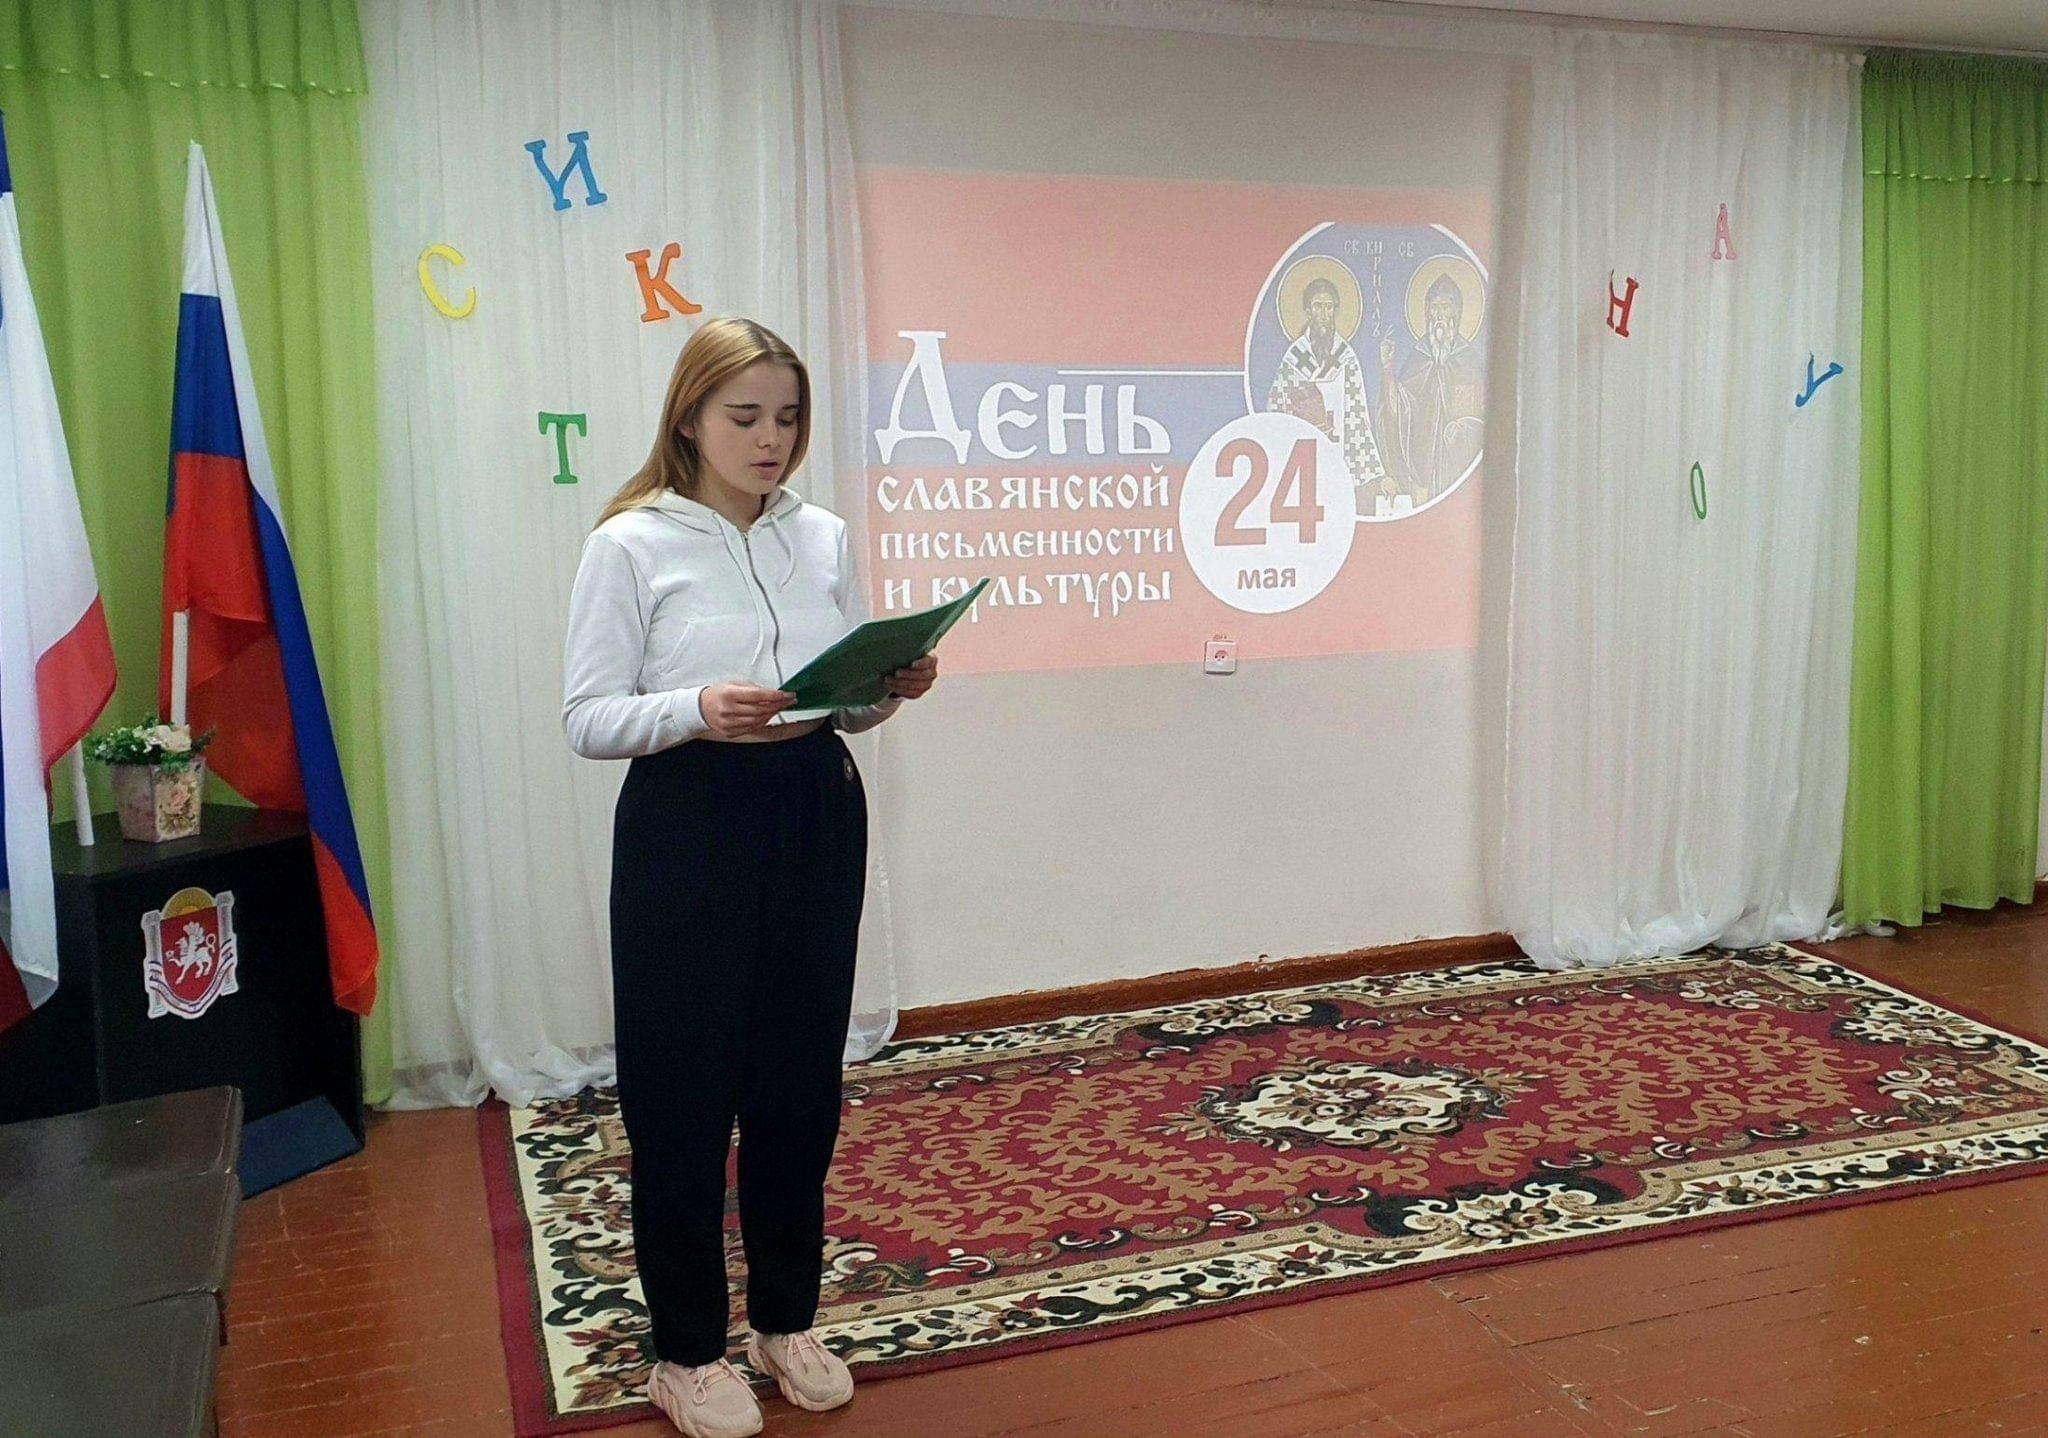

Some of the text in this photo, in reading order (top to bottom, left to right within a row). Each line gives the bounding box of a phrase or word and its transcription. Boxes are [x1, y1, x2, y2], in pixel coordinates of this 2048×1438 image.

[524, 131, 608, 212] И
[418, 243, 477, 319] С
[625, 242, 703, 323] К
[1606, 269, 1640, 338] Н
[874, 330, 1172, 465] День
[538, 411, 587, 484] Т
[877, 462, 1170, 513] славянской
[1214, 437, 1325, 547] 24
[880, 527, 1174, 560] письменности
[1237, 567, 1297, 590] мая
